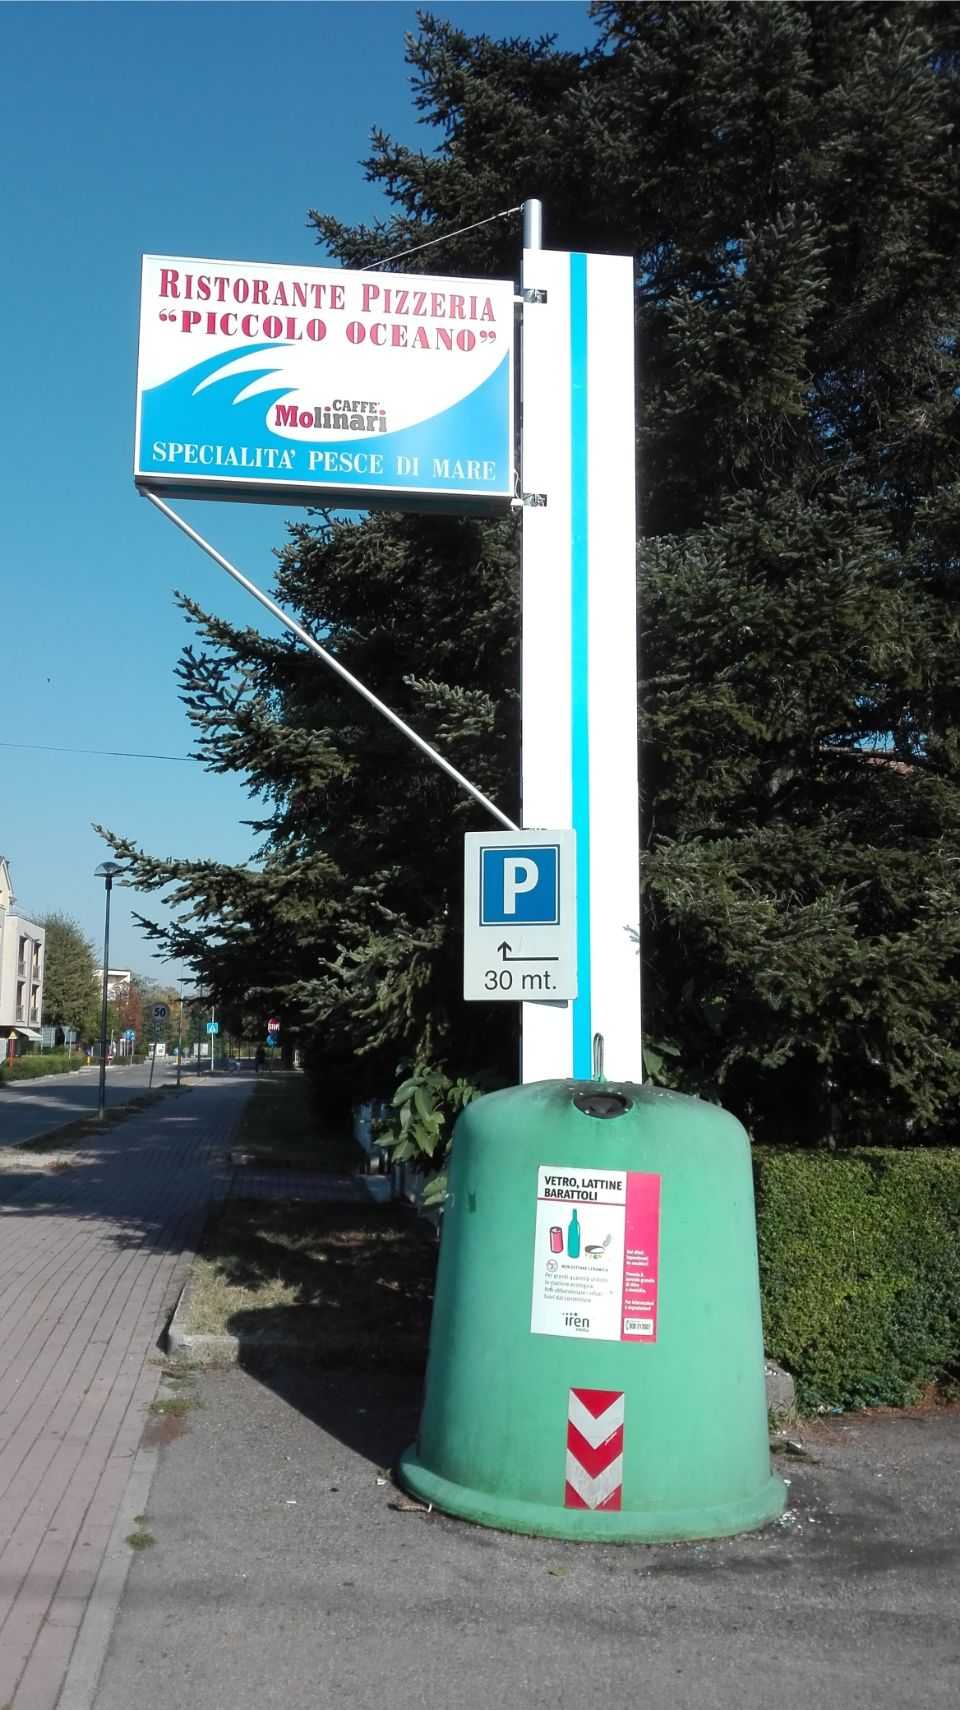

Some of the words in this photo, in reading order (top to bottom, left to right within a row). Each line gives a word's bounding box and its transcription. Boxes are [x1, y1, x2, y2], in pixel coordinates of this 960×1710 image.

[159, 268, 345, 310] RISTORANTE
[362, 283, 496, 322] PIZZERIA
[275, 404, 387, 433] Molinari
[309, 450, 383, 475] PESCE
[397, 456, 419, 476] DI
[433, 458, 496, 481] MARE
[503, 857, 540, 915] P
[484, 970, 513, 990] 30
[522, 969, 557, 990] mt.
[153, 1007, 166, 1017] 50
[544, 1176, 580, 1190] VETRO,
[581, 1178, 623, 1191] LATTINE
[544, 1188, 598, 1201] BARATTOLI
[565, 1313, 590, 1329] iren
